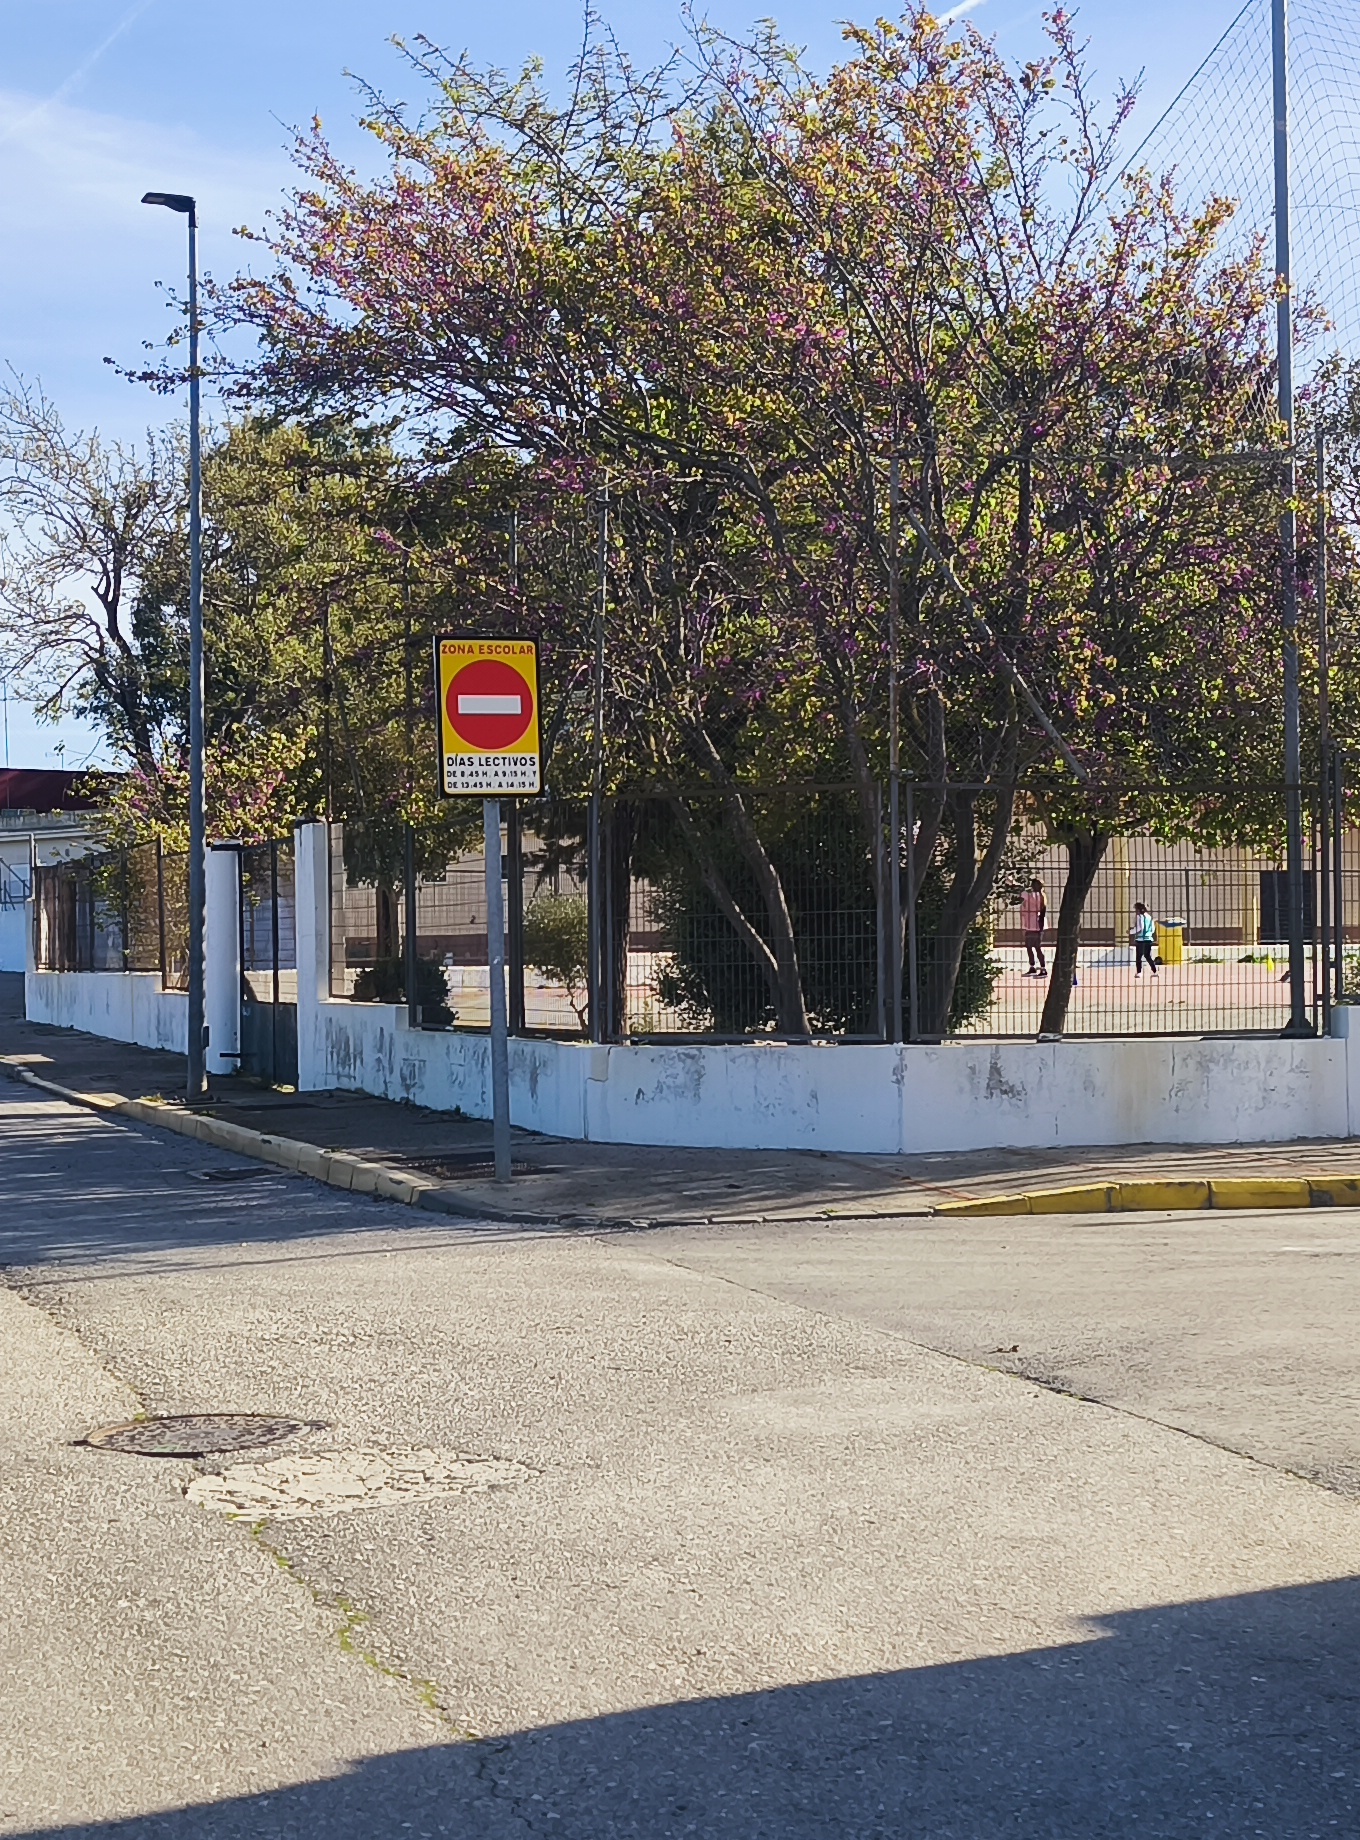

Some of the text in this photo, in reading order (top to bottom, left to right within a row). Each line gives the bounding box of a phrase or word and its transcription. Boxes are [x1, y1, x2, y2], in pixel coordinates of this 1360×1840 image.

[441, 644, 534, 655] ZONA ESCOLAR
[446, 753, 536, 767] DÍAS LECTIVOS
[446, 770, 458, 778] DE
[493, 770, 499, 778] A
[447, 781, 458, 789] DE
[497, 781, 503, 789] A
